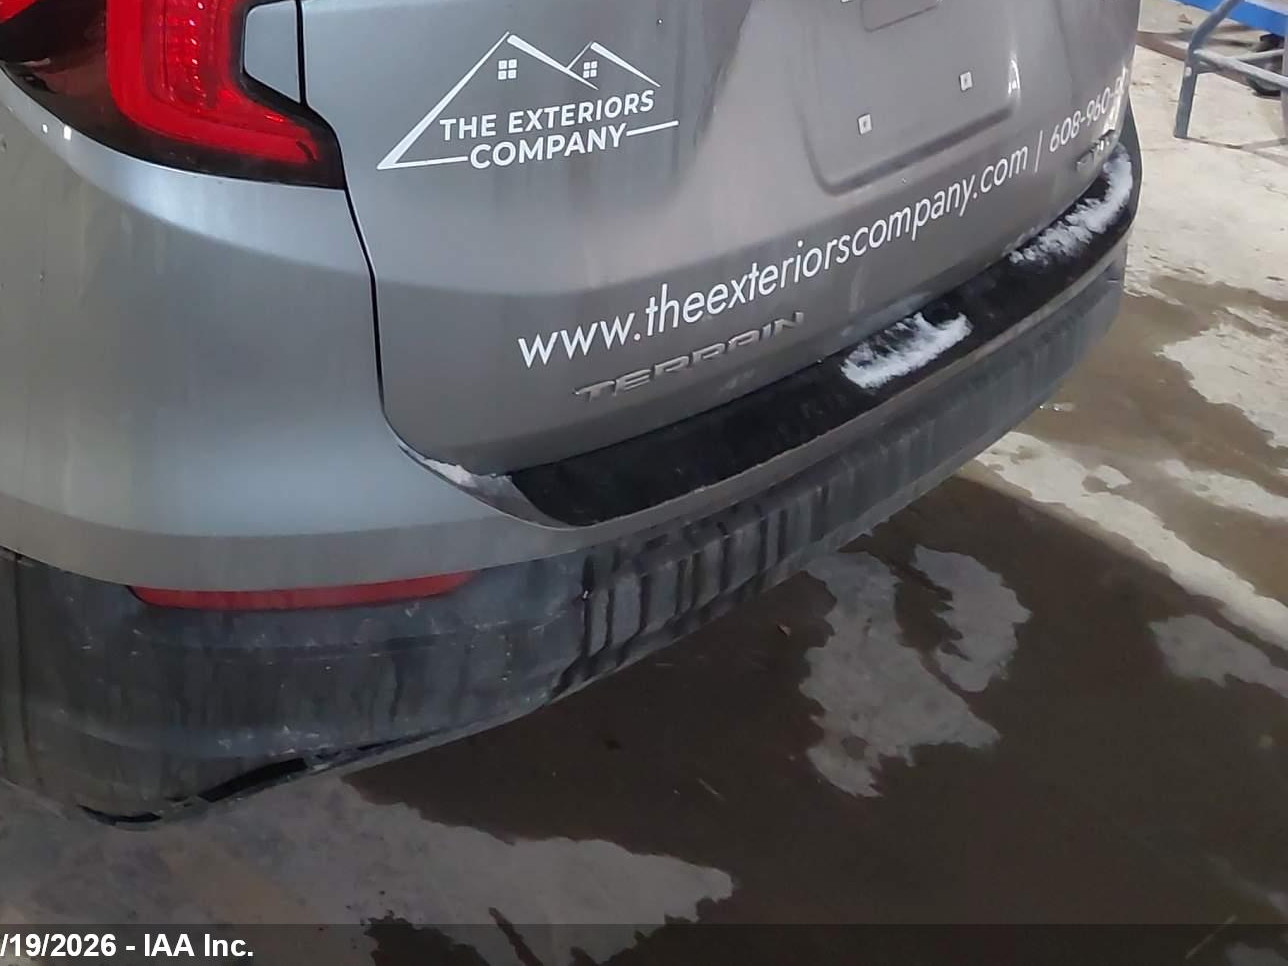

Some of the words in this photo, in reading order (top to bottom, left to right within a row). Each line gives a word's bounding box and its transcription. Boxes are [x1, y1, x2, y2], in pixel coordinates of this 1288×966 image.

[439, 114, 497, 141] THE
[508, 89, 655, 134] EXTERIORS
[470, 123, 627, 169] COMPANY
[518, 145, 1028, 369] www.theexteriorscompany.com
[573, 311, 805, 402] TERRAIN
